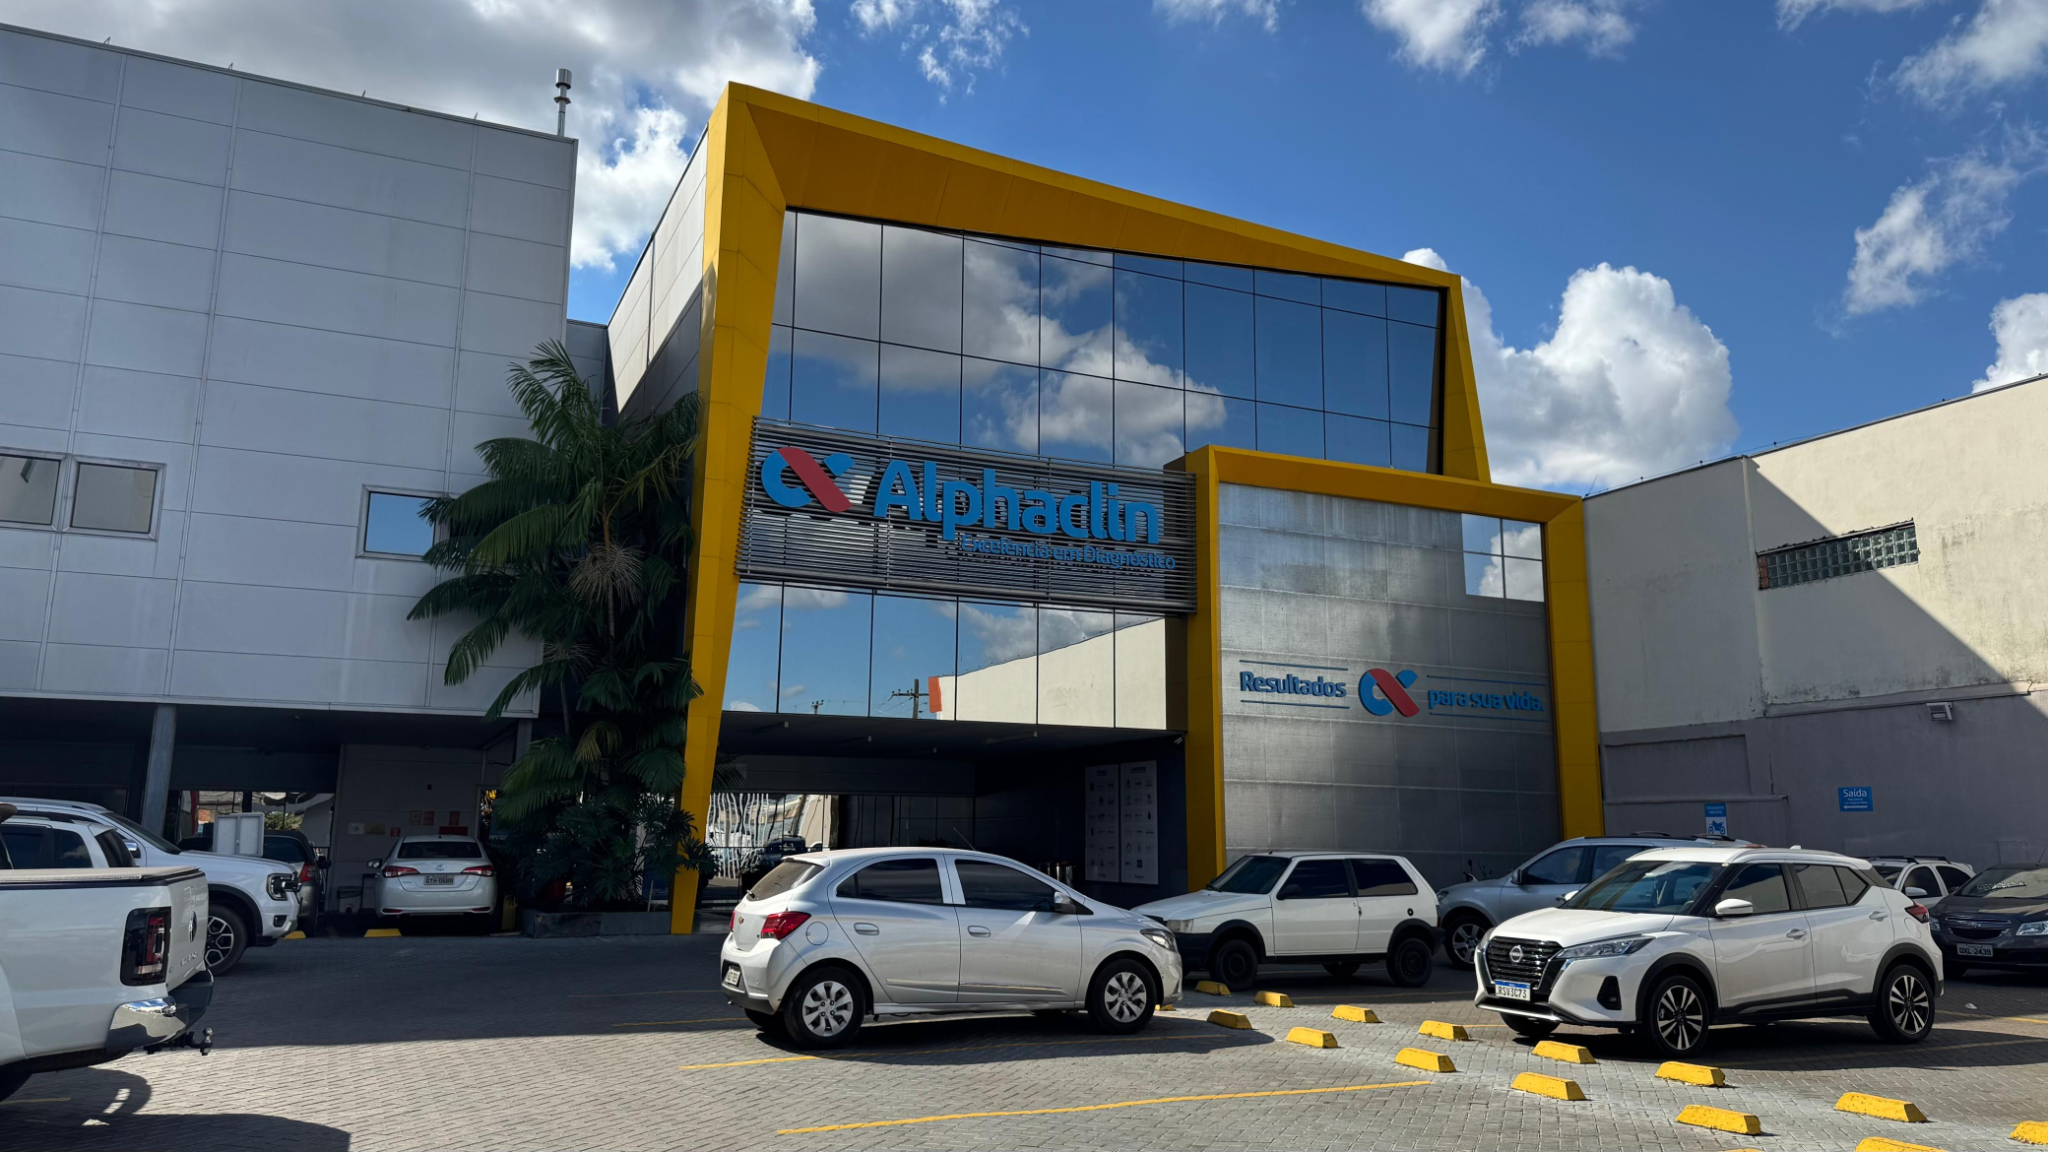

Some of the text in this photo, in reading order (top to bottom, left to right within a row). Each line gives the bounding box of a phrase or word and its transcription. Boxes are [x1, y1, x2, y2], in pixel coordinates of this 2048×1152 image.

[873, 459, 1160, 544] Alphaclin
[961, 534, 1176, 569] Excelência em Diagnóstico
[1240, 671, 1347, 698] Resultados
[1428, 688, 1469, 710] para
[1470, 692, 1503, 710] sua
[1843, 788, 1867, 798] Saída
